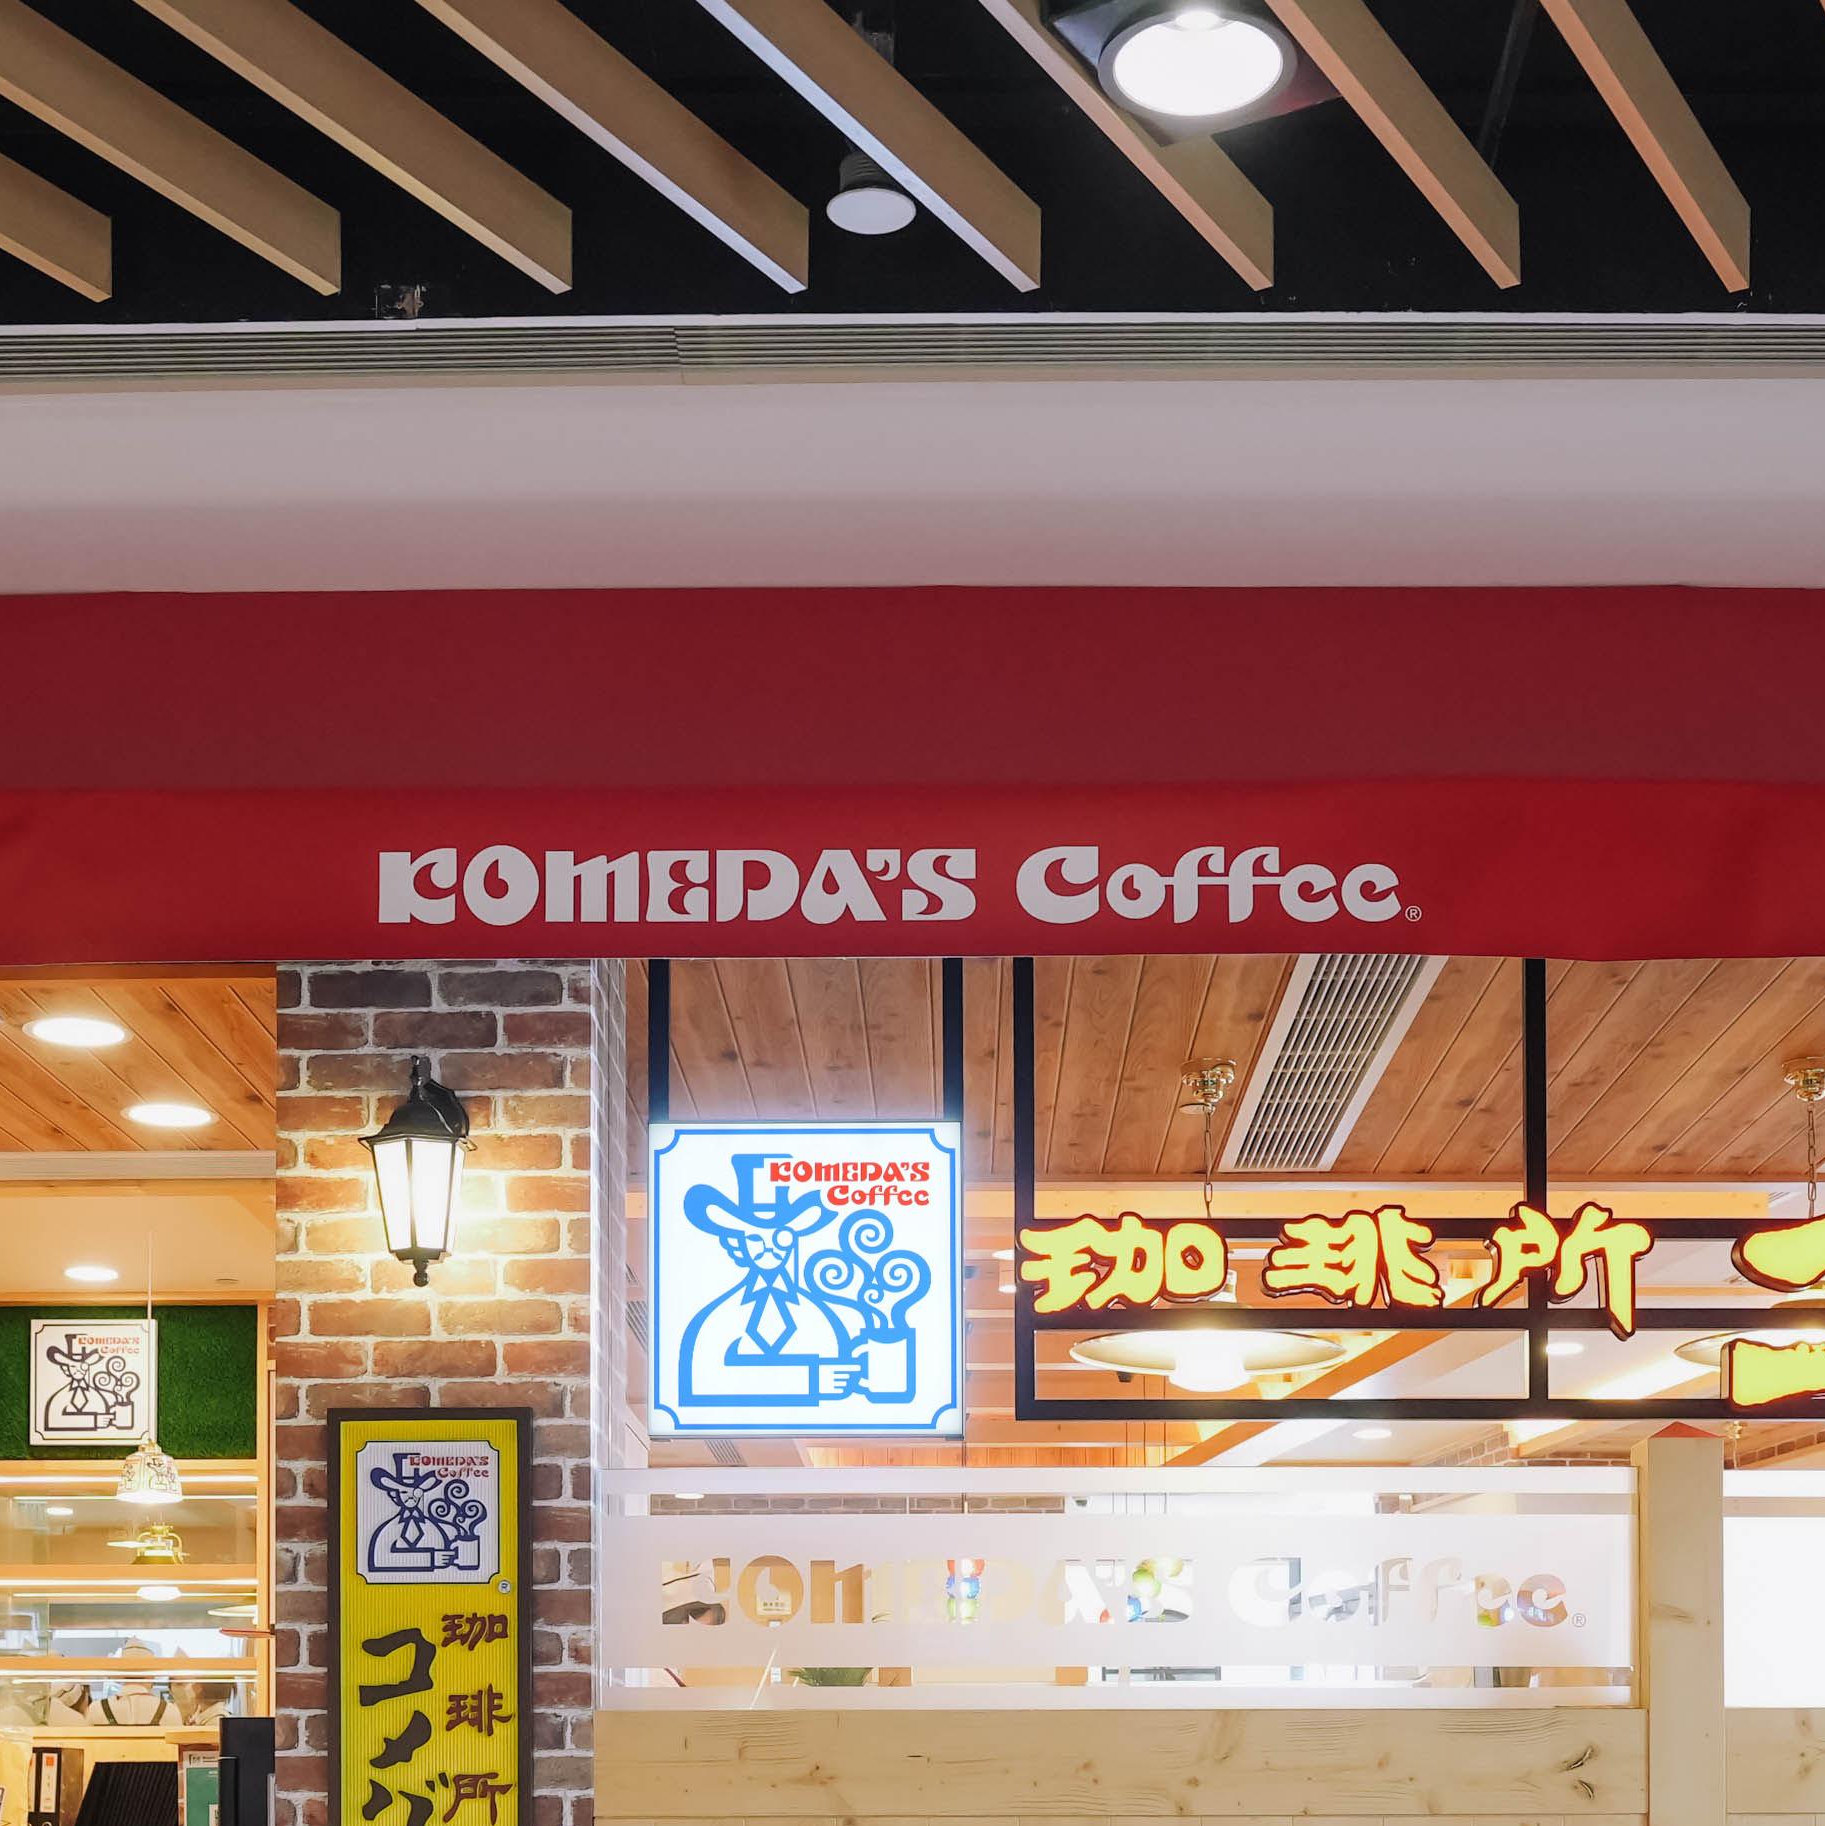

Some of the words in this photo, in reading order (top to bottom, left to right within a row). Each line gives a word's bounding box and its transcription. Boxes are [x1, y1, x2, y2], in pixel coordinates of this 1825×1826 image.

[378, 844, 977, 925] KOMEDA'S
[1015, 845, 1402, 924] Coffee
[770, 1160, 930, 1183] KOMEDA'S
[827, 1185, 929, 1207] Coffee
[409, 1455, 490, 1467] KOMEDA'S
[437, 1467, 490, 1479] Coffee
